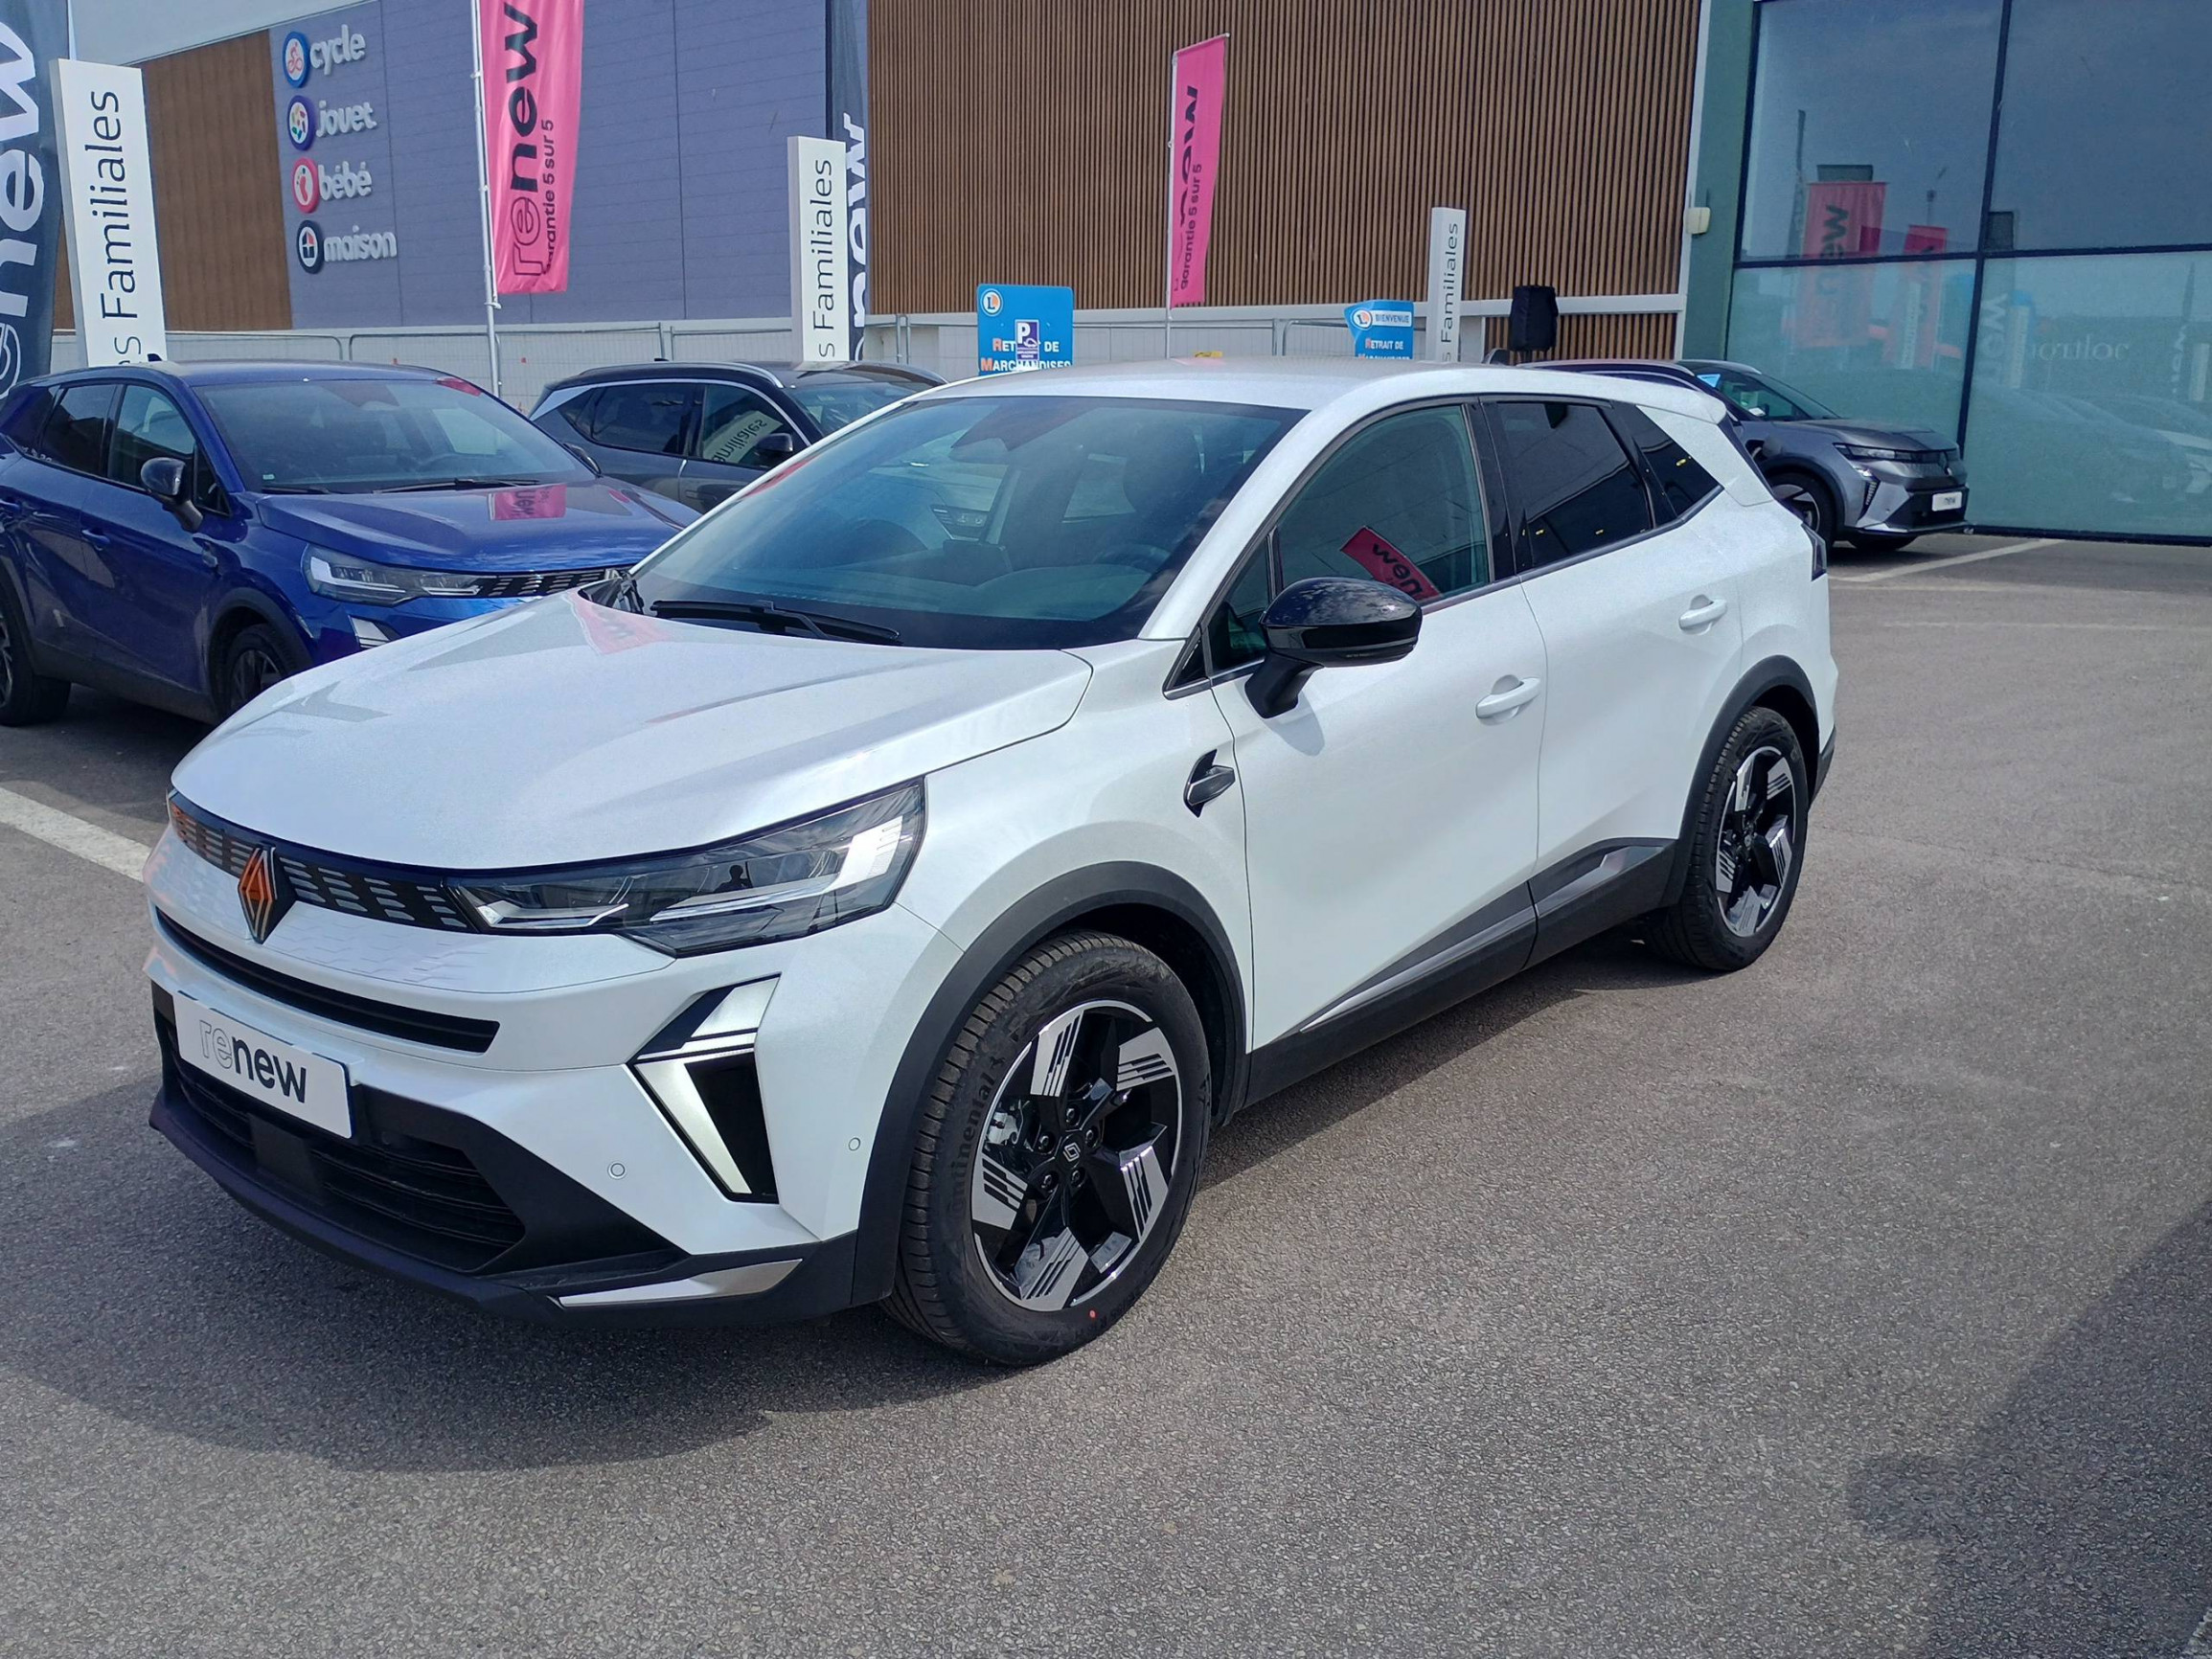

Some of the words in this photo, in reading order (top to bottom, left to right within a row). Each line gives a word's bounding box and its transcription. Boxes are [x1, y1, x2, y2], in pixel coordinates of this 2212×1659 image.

[309, 24, 366, 75] cycle
[316, 100, 377, 138] jouet
[541, 119, 554, 131] 5
[504, 2, 541, 277] renew
[542, 135, 555, 170] sur
[317, 161, 373, 201] bébé
[542, 172, 555, 185] 5
[84, 91, 138, 319] Familiales
[323, 225, 398, 262] maison
[810, 159, 833, 330] Familiales
[1179, 220, 1197, 290] garantie
[1191, 176, 1201, 204] sur
[1441, 222, 1458, 343] Familiales
[1043, 341, 1060, 352] DE
[1365, 338, 1393, 350] RETRAIT
[1395, 340, 1404, 350] DE
[199, 1019, 307, 1103] renew
